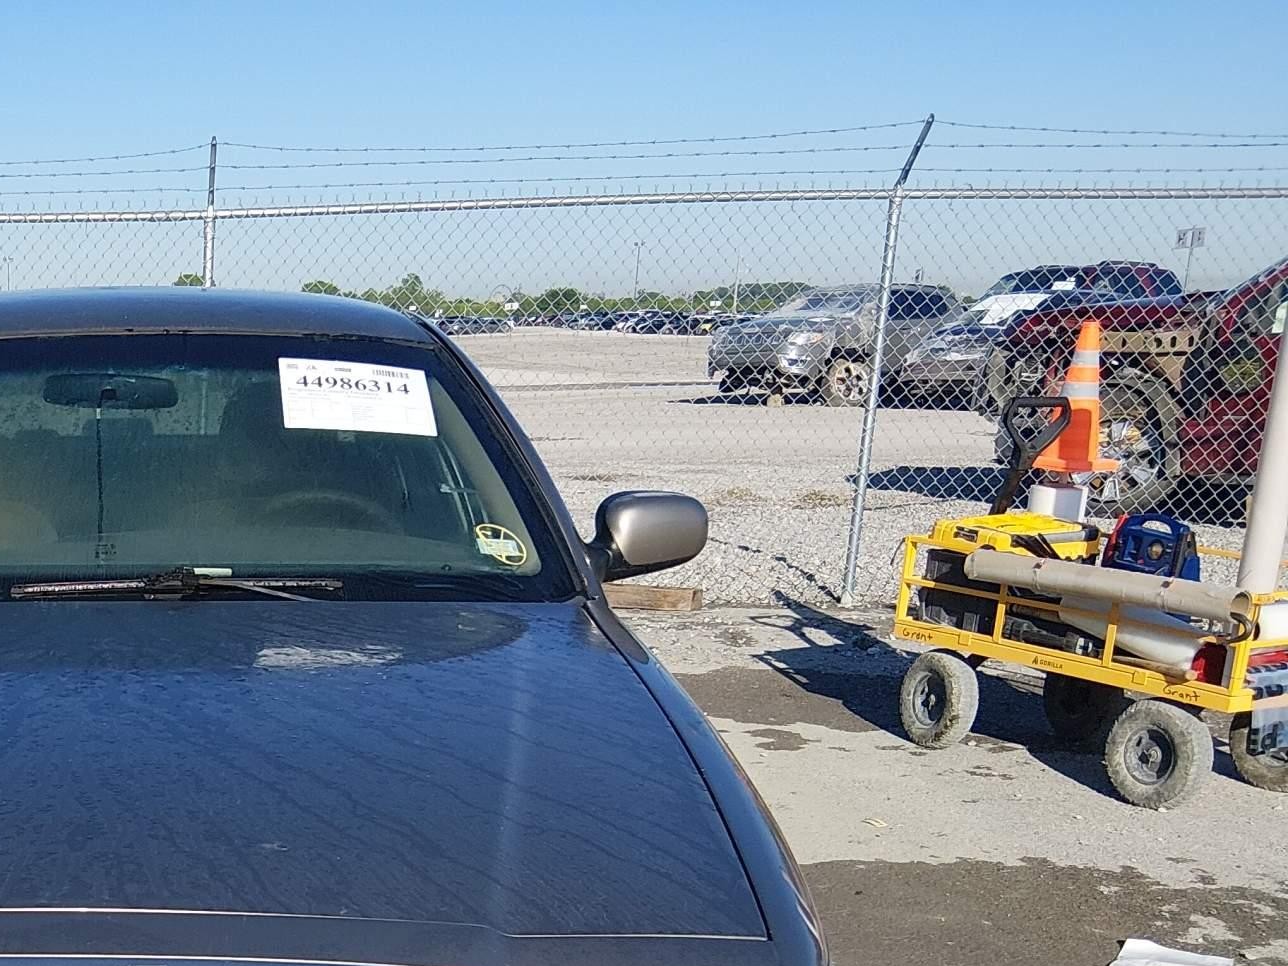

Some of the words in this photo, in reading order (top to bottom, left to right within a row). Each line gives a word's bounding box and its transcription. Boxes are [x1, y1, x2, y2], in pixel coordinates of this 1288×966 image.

[296, 375, 410, 395] 44986314
[902, 627, 934, 642] Grant
[1039, 659, 1063, 670] GORILLA
[1162, 684, 1201, 702] Grant
